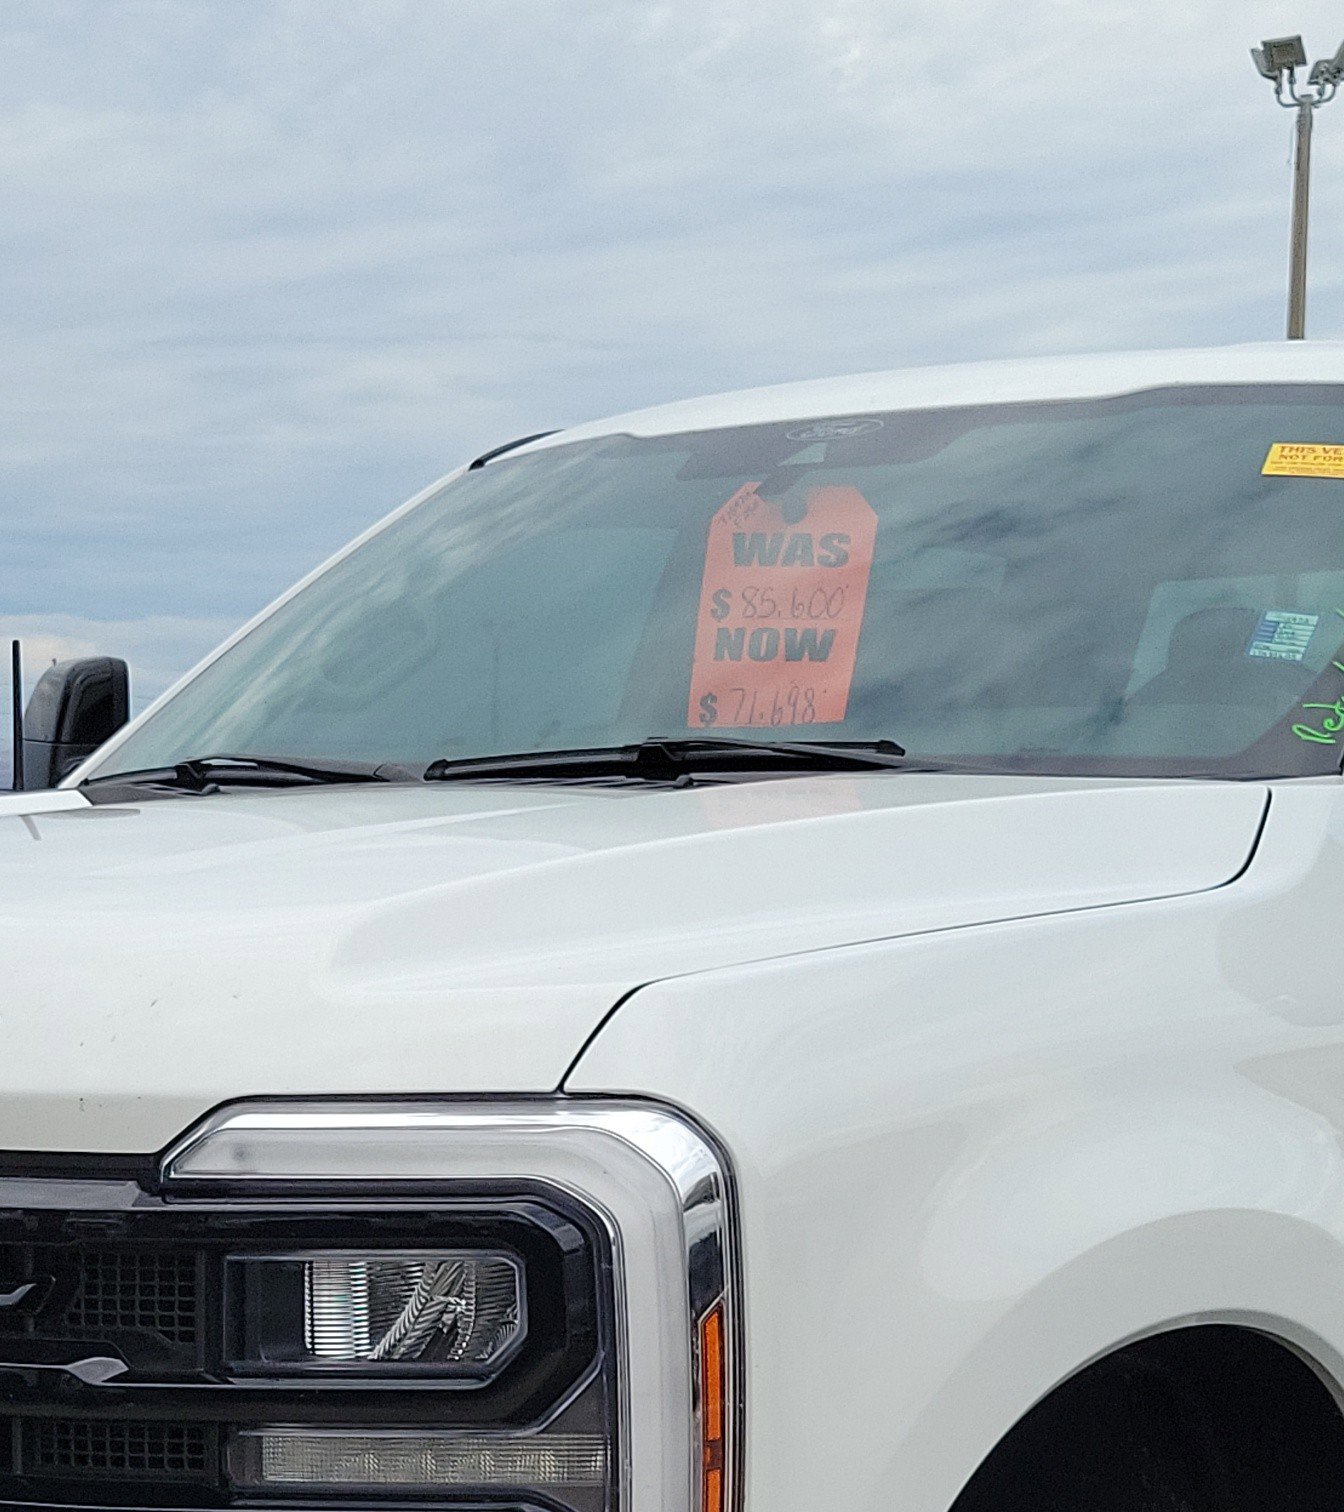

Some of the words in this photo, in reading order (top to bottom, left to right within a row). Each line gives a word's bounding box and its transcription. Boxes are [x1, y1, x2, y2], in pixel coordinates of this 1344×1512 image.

[1279, 445, 1317, 454] THIS
[1313, 455, 1344, 463] FOR
[732, 532, 851, 568] WAS
[709, 586, 733, 623] $
[713, 627, 837, 663] NOW
[698, 691, 718, 726] $
